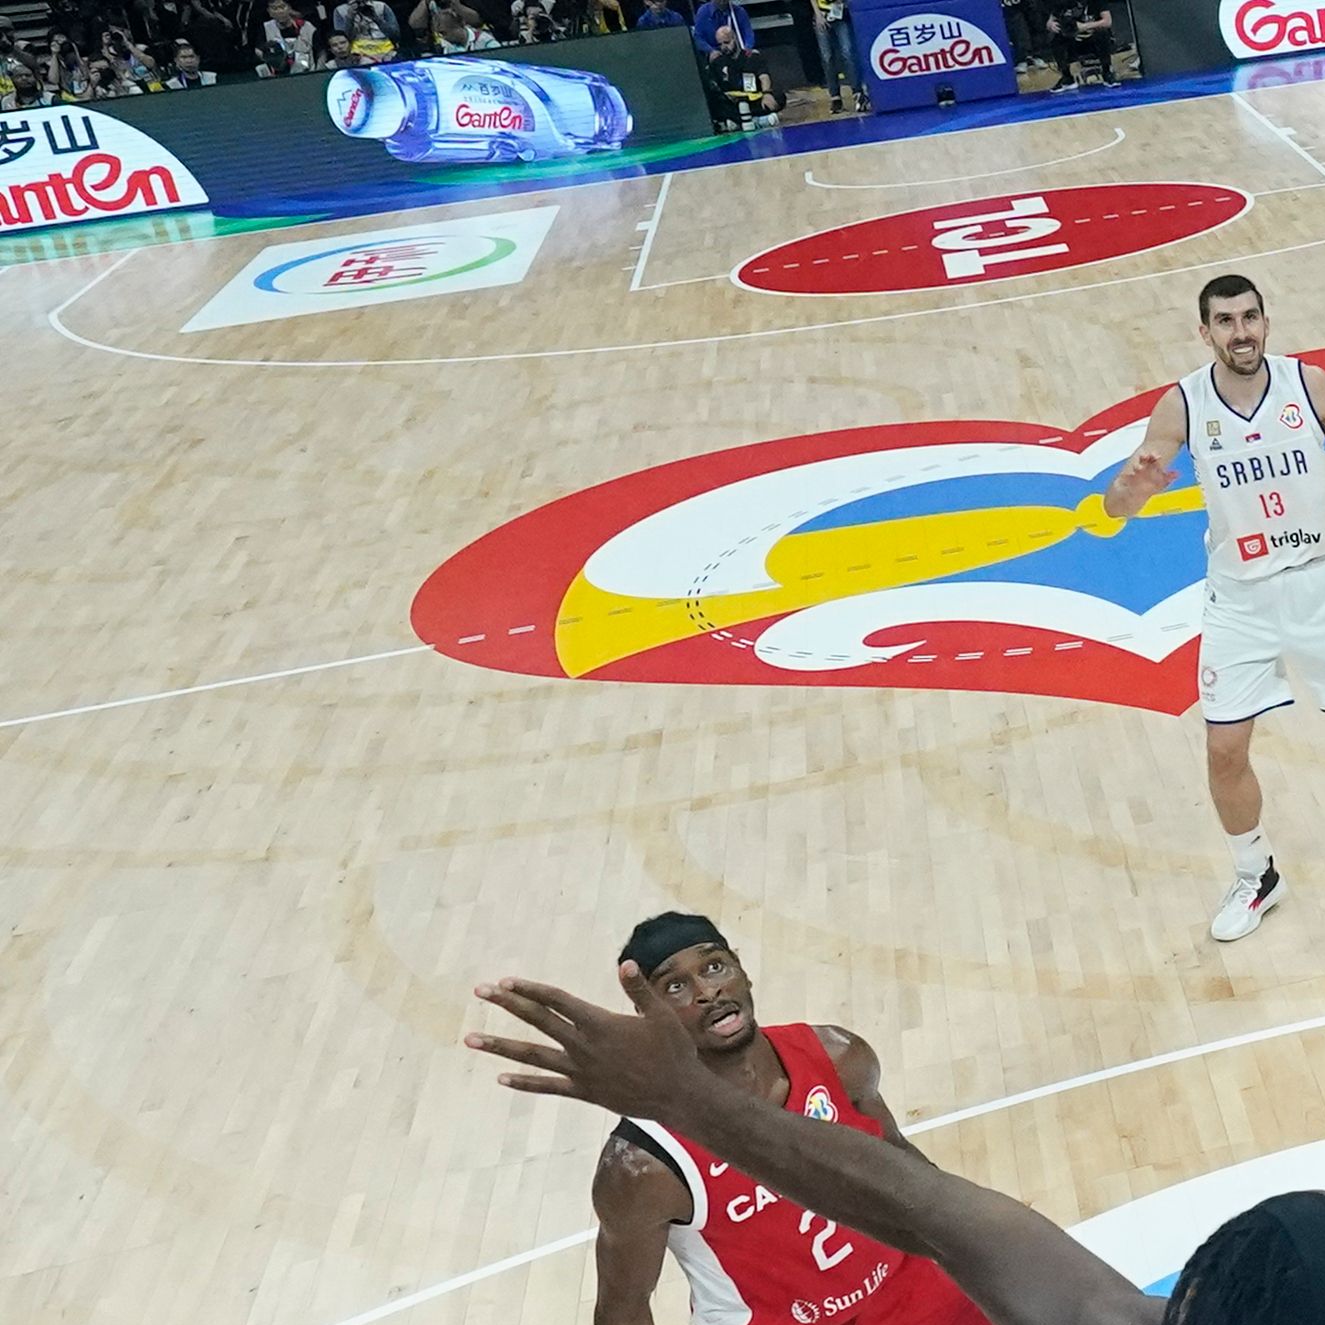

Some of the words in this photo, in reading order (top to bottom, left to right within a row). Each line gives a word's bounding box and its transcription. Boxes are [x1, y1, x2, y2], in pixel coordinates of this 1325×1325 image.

[887, 21, 963, 48] 百岁山
[931, 195, 1070, 280] TCL
[1216, 449, 1309, 489] SRBIJA
[1259, 491, 1285, 519] 13
[1270, 528, 1322, 549] triglav
[799, 1209, 854, 1272] 2
[823, 1288, 864, 1317] Sun
[863, 1262, 889, 1296] Life
